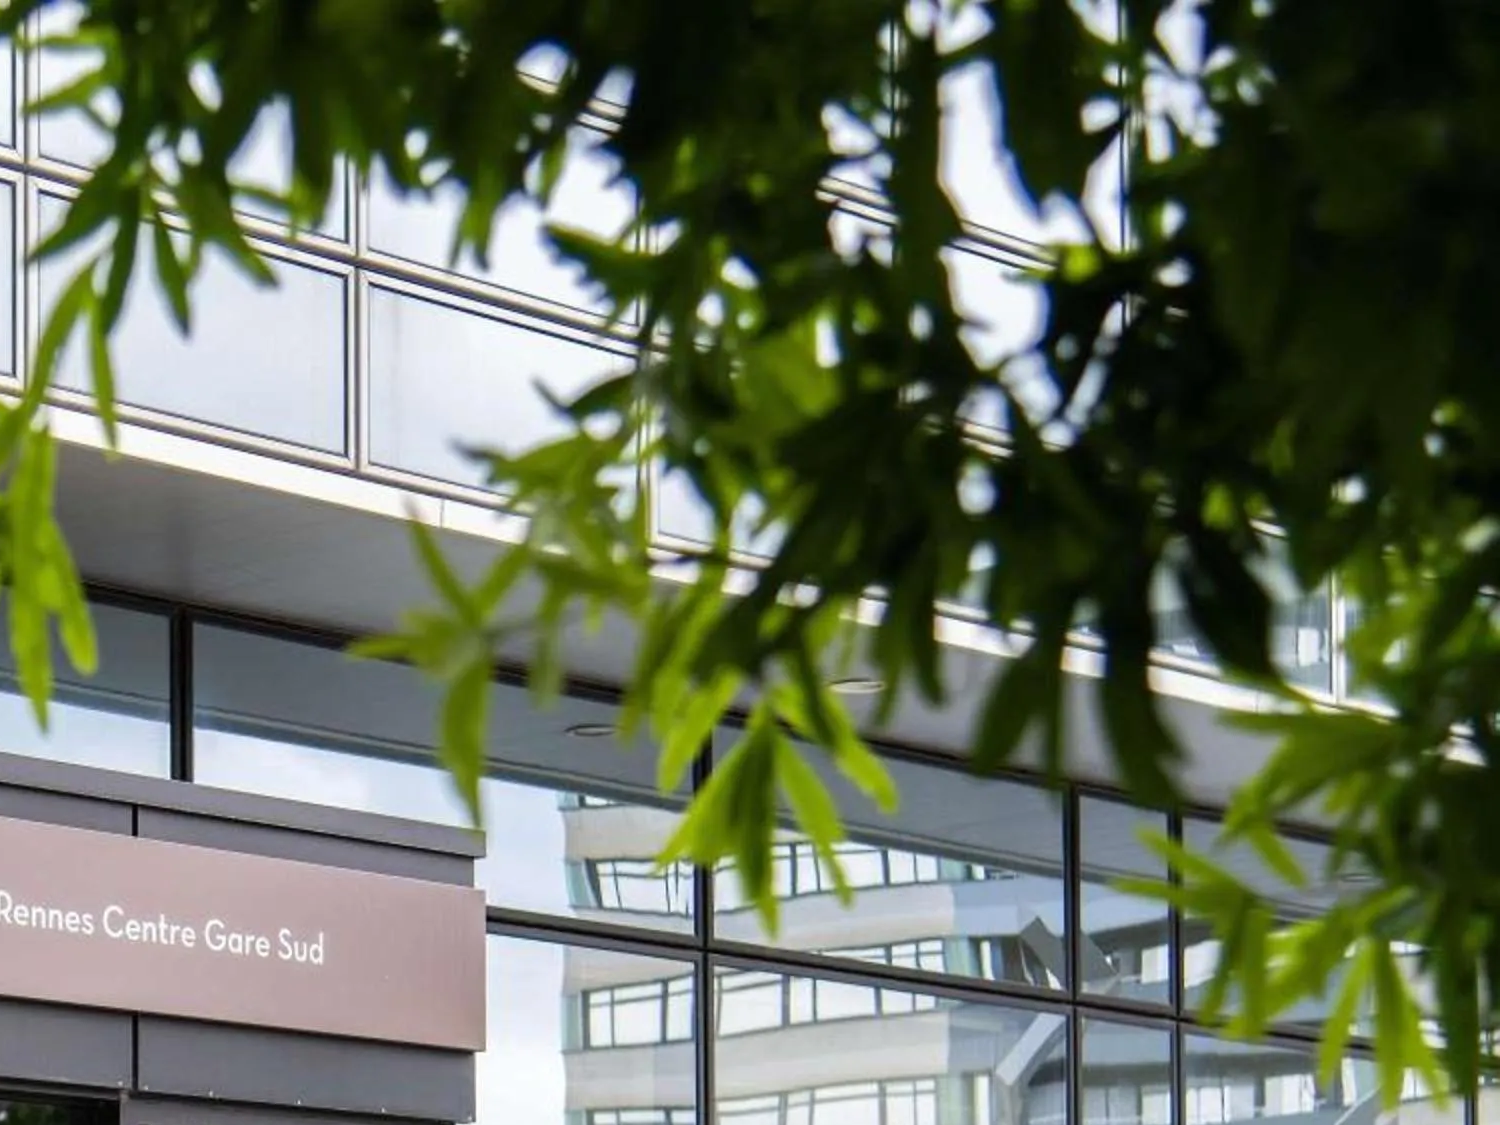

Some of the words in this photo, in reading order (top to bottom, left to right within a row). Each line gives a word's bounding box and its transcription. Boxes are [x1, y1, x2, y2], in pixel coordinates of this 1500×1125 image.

[102, 905, 197, 948] Centre
[204, 918, 270, 957] Gare
[277, 927, 324, 965] Sud
